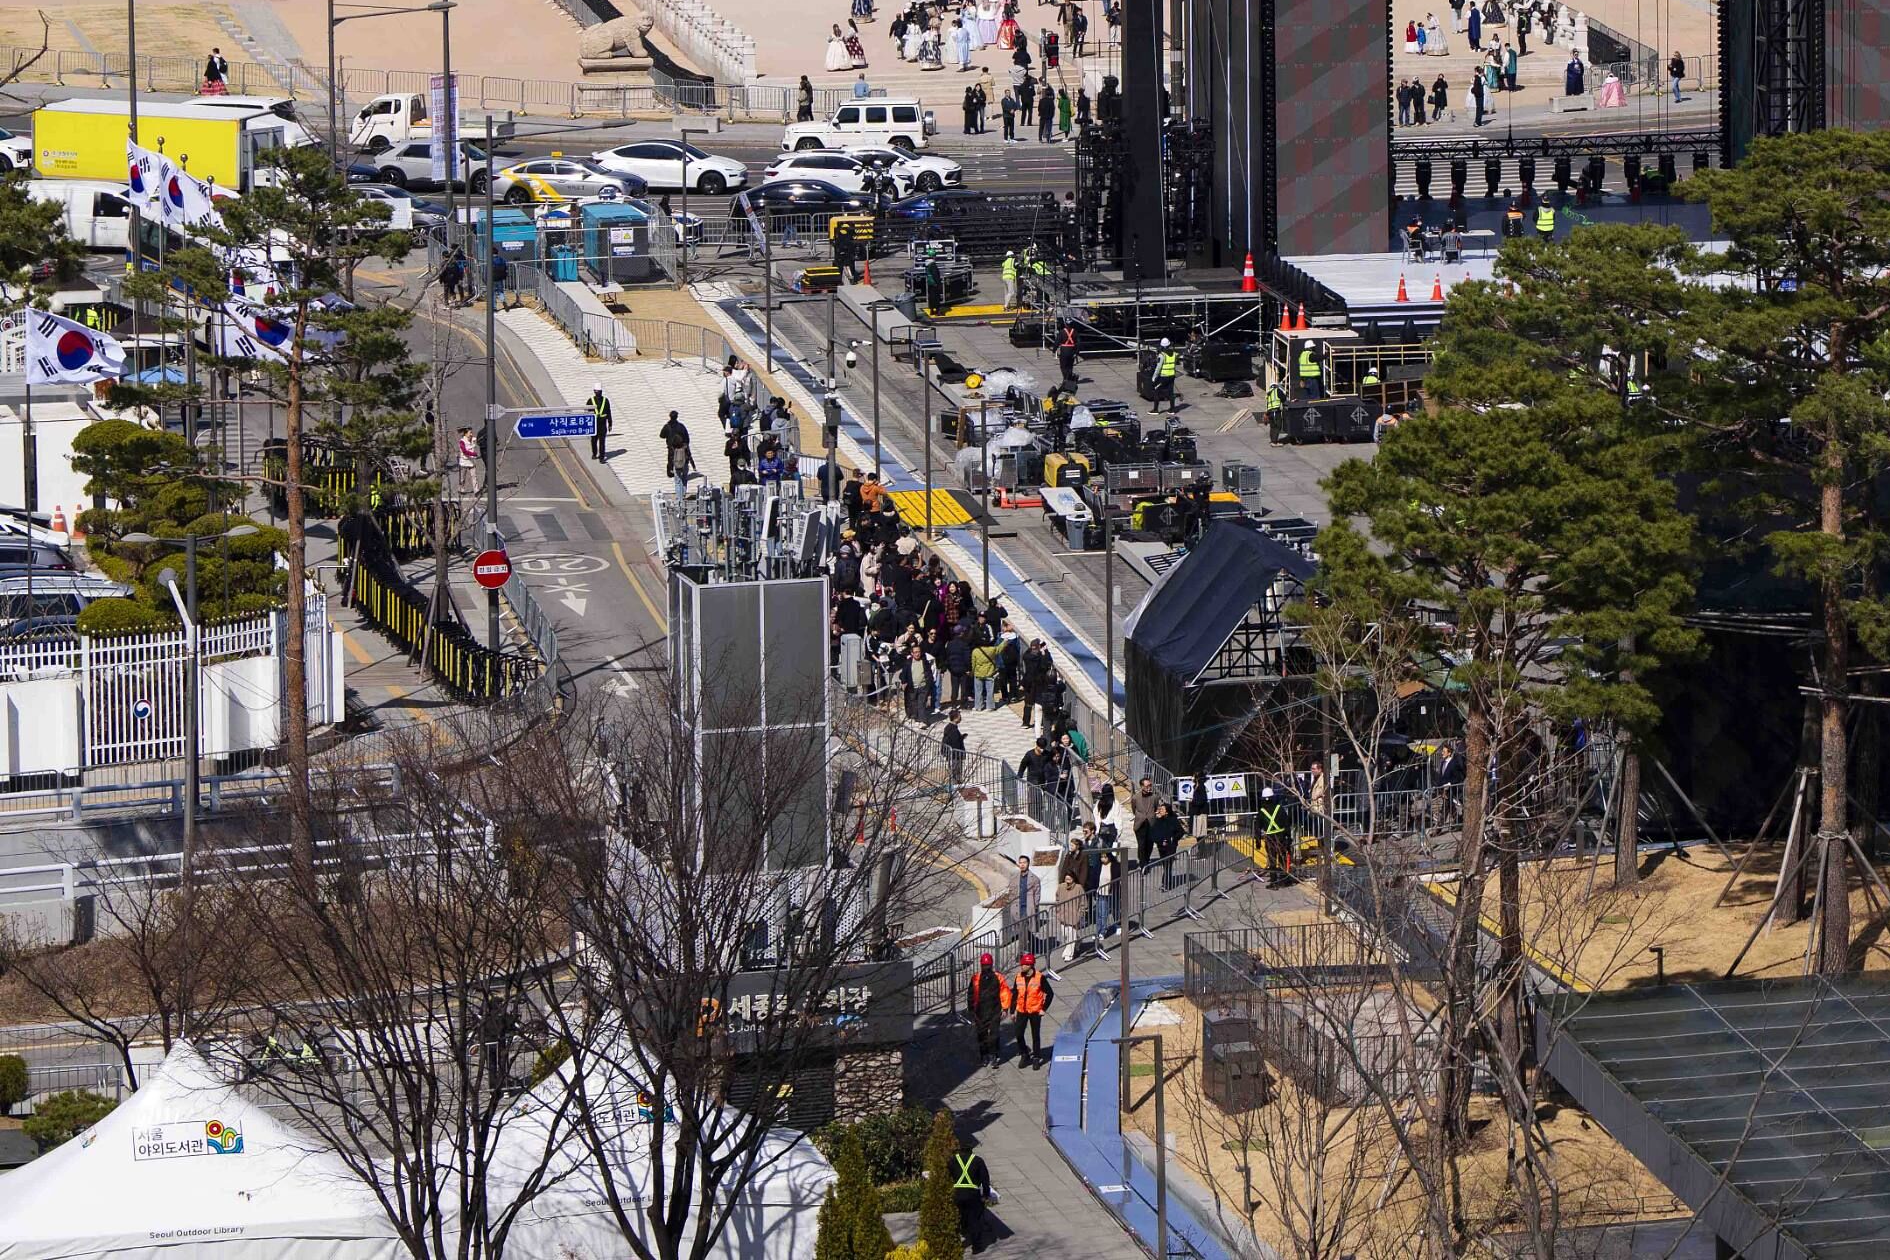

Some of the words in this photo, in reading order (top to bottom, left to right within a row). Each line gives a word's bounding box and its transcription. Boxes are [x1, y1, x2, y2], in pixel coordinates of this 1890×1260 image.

[549, 416, 594, 427] 사직로8길
[550, 428, 577, 436] Sajik-ro
[578, 426, 594, 435] 8-gil
[479, 565, 507, 574] 진입금지
[138, 1127, 163, 1142] 서울
[138, 1139, 204, 1157] 야외도서관
[149, 1230, 174, 1239] Seoul
[176, 1228, 211, 1238] Outdoor
[214, 1225, 245, 1237] Library
